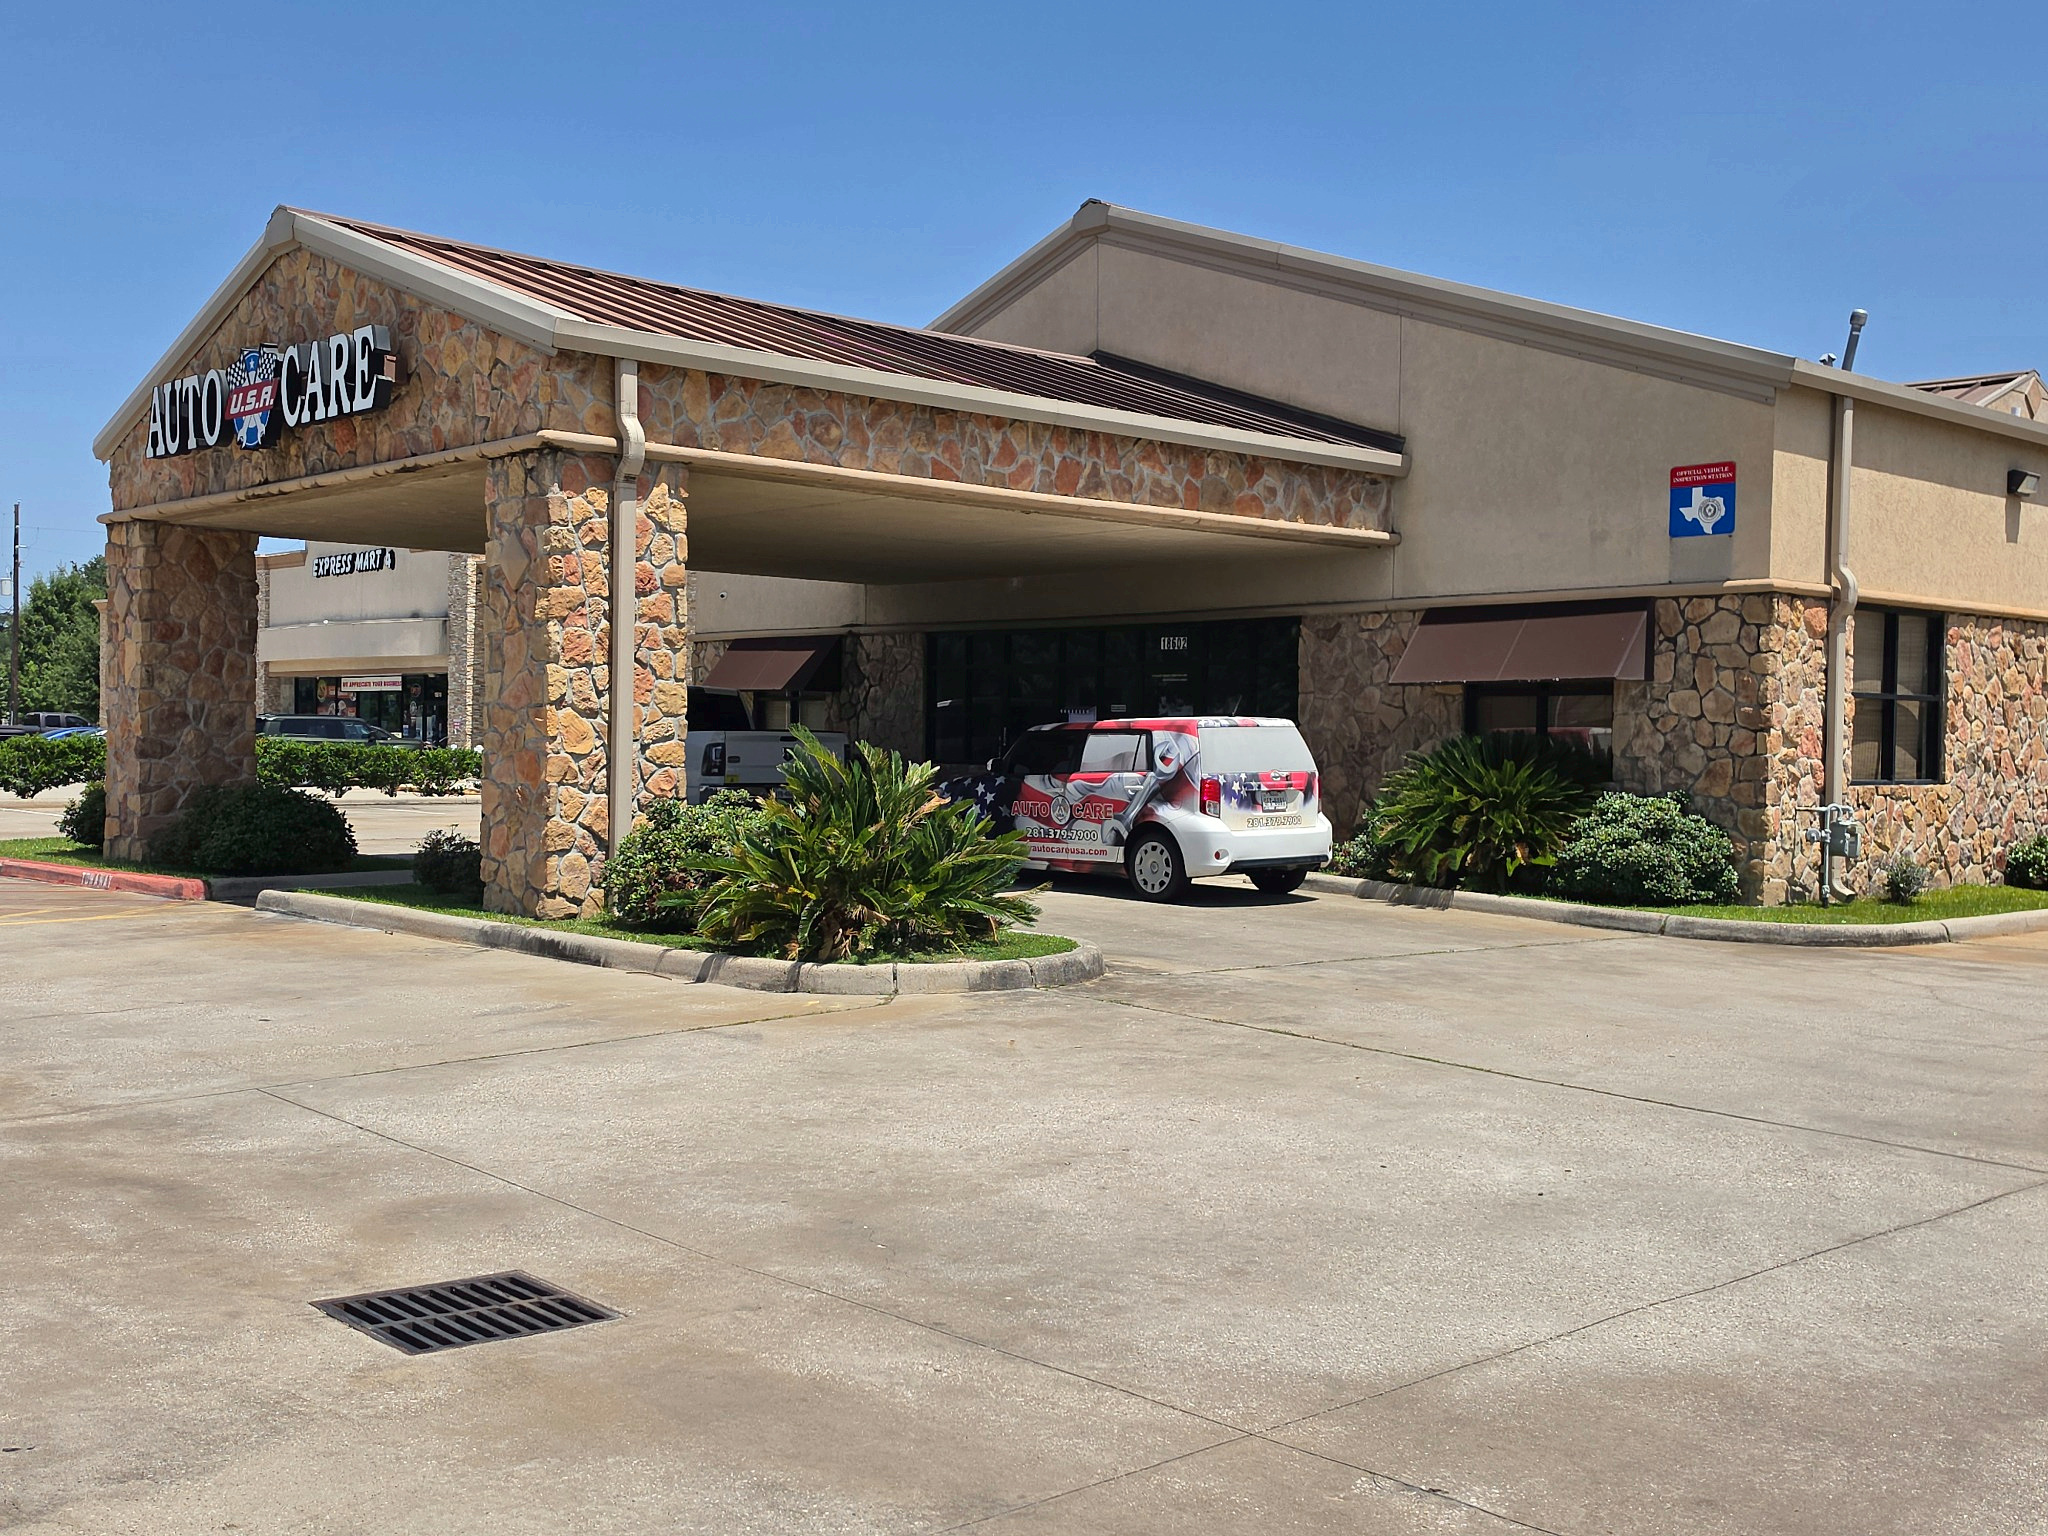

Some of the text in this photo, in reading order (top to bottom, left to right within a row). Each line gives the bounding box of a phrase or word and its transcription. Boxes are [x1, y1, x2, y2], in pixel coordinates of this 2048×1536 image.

[281, 325, 375, 427] CARE
[230, 387, 274, 415] U.S.A.
[146, 368, 222, 458] AUTO
[1673, 475, 1707, 483] INSPECTION
[313, 554, 353, 577] EXPRESS
[355, 549, 382, 571] MART
[1160, 636, 1188, 650] 18602
[1011, 801, 1114, 820] AUTO CARE
[1246, 815, 1303, 828] 281.379.7900
[1026, 826, 1099, 841] 281.379.7900
